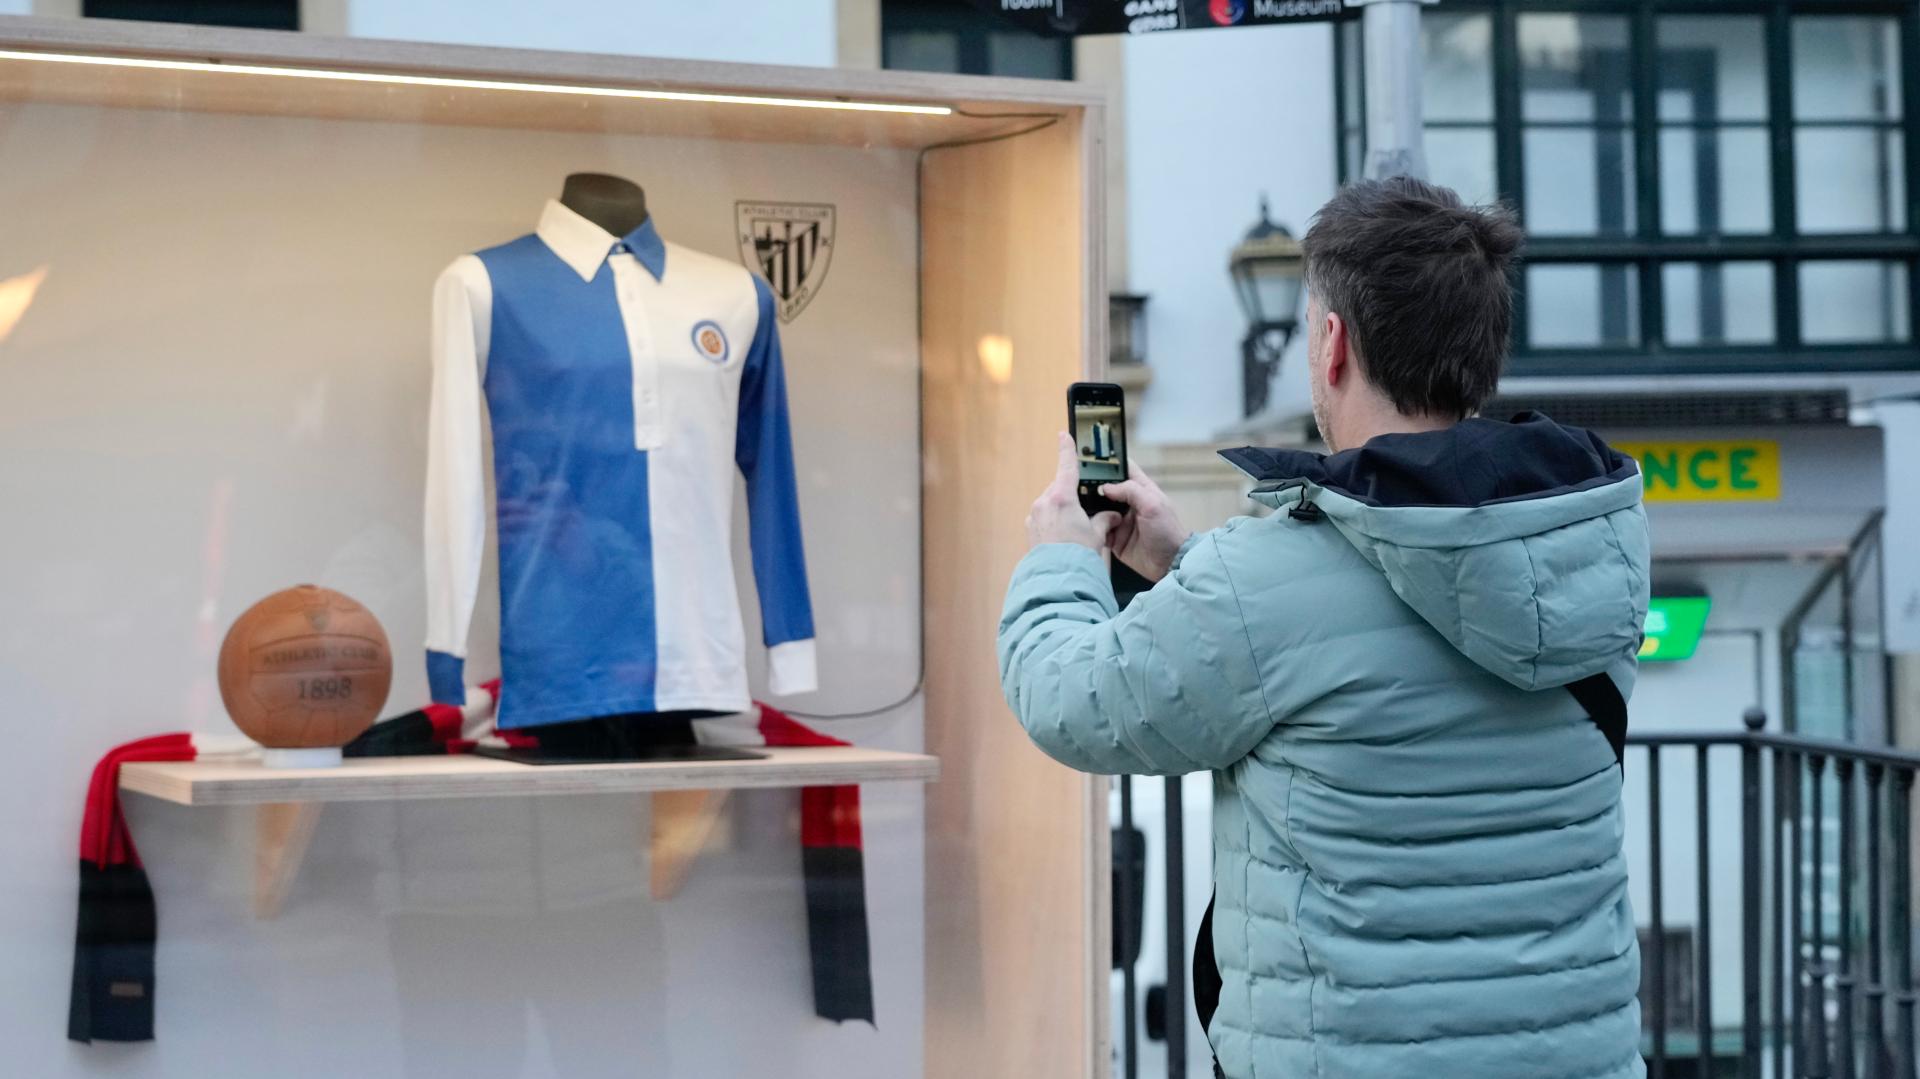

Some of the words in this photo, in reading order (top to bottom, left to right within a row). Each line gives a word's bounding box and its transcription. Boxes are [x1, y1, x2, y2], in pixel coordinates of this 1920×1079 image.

[1253, 0, 1341, 18] Museum
[1643, 449, 1760, 491] NCE
[297, 676, 353, 700] 1898
